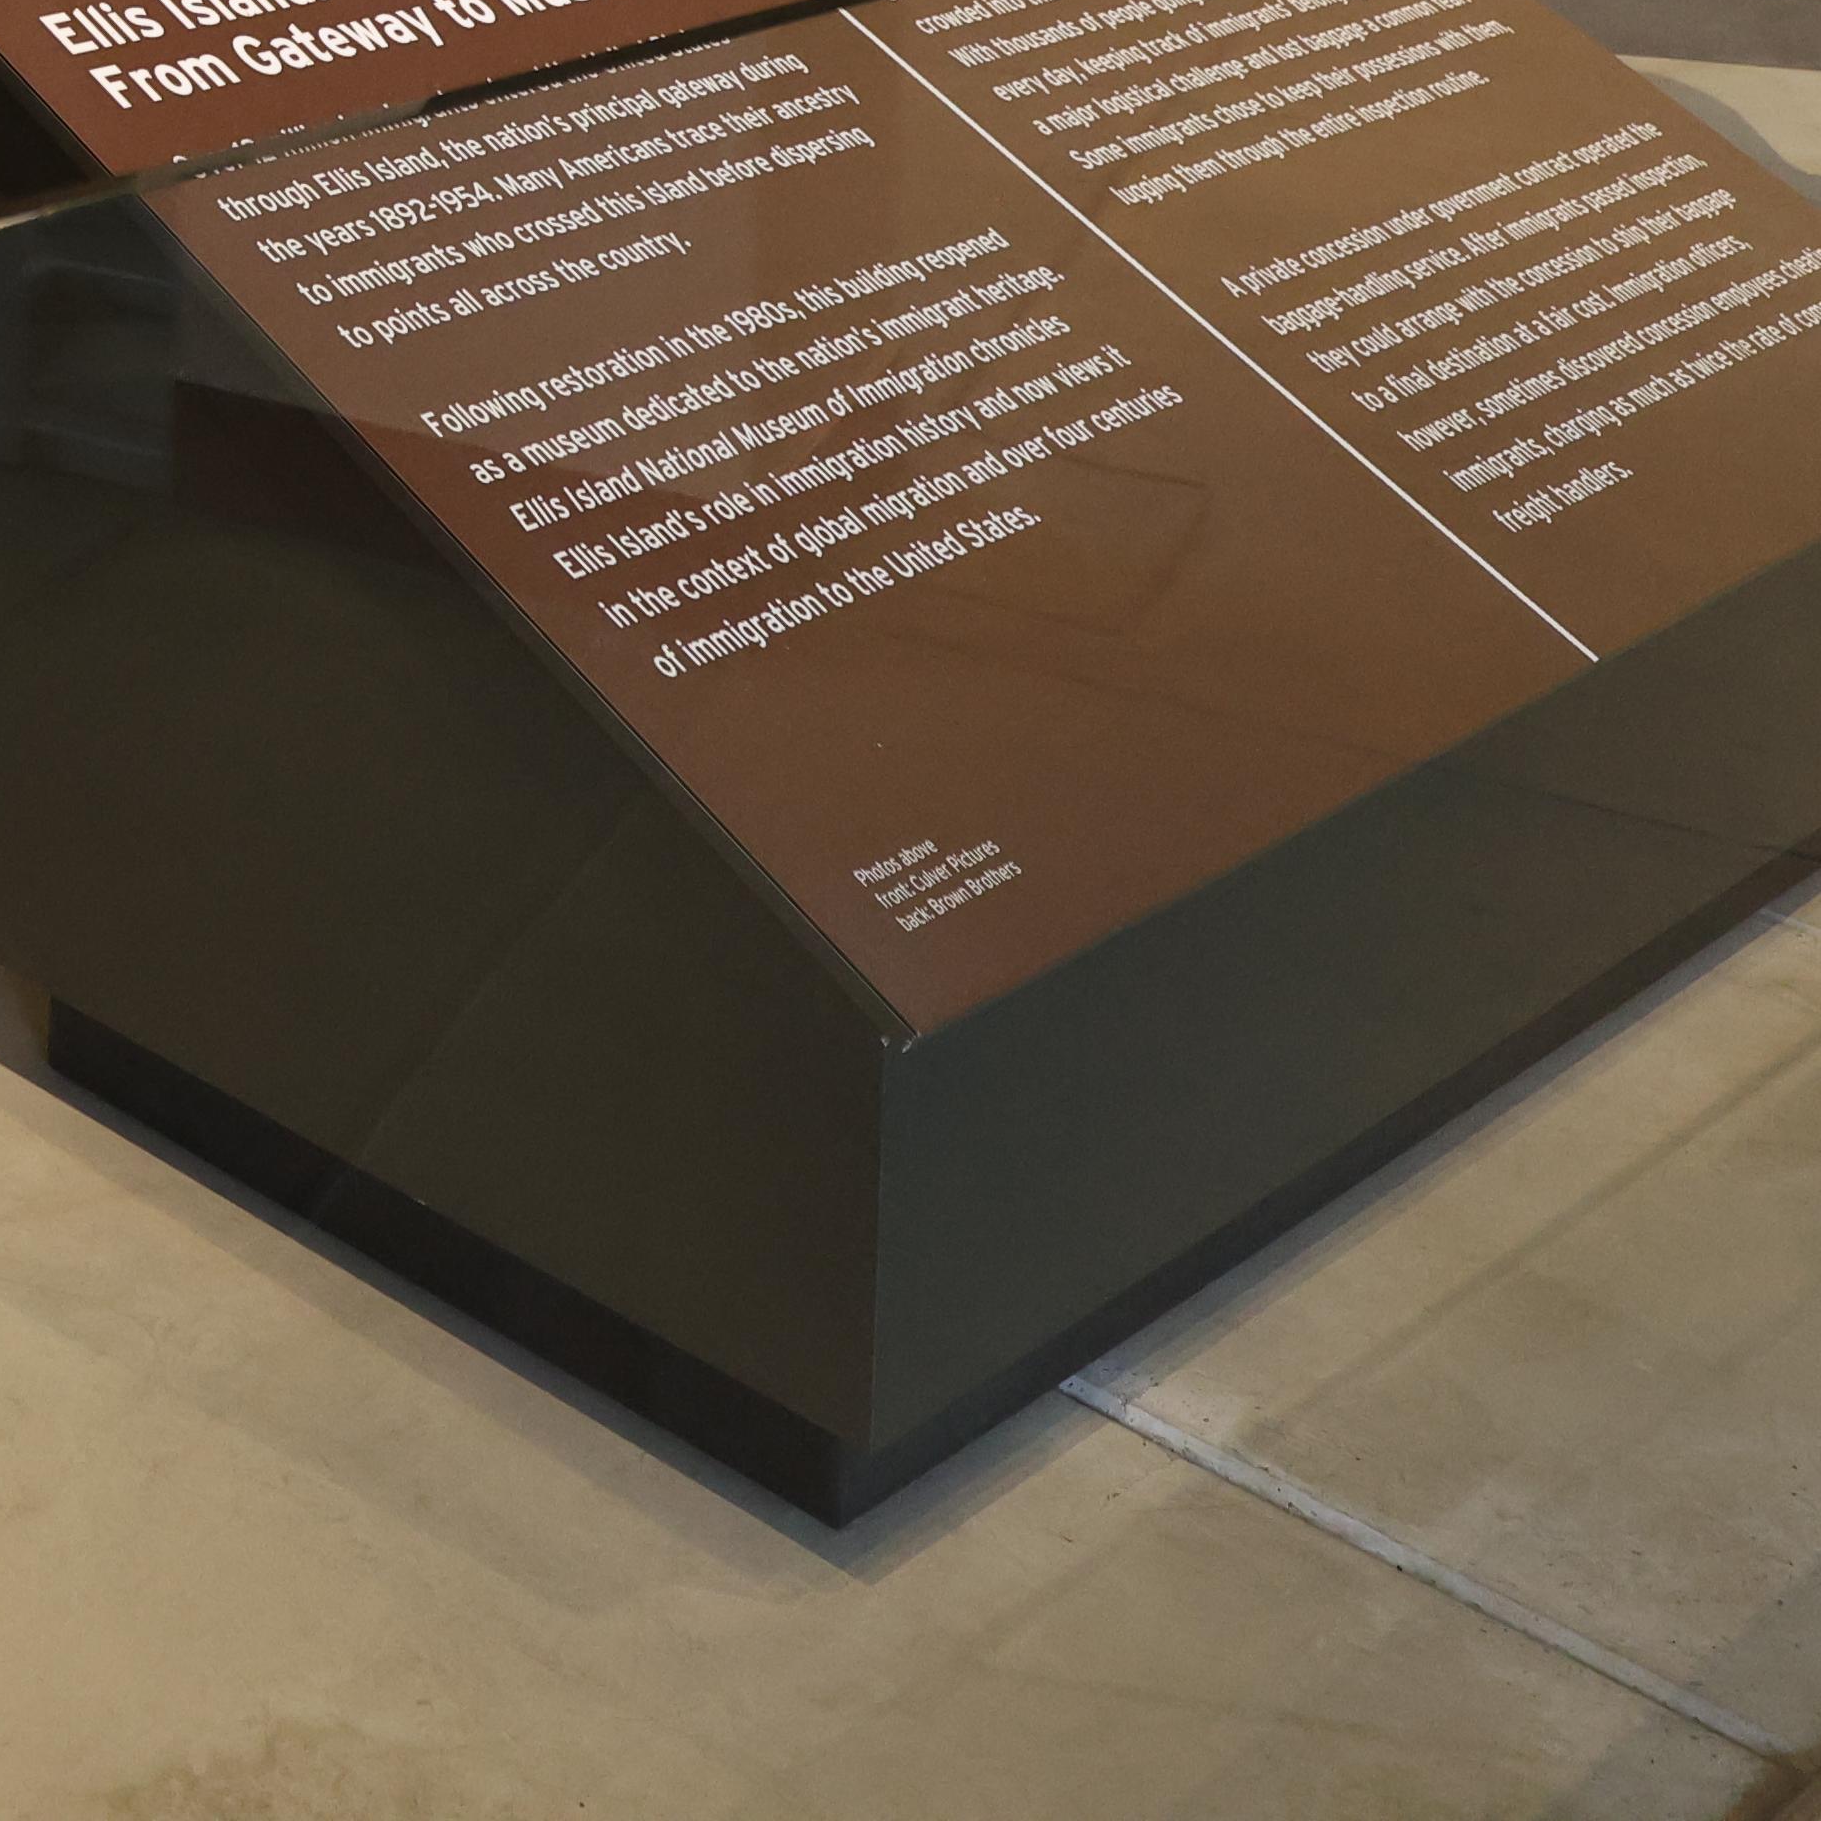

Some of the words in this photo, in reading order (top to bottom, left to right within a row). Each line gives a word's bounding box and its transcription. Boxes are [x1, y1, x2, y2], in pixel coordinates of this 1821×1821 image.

[38, 1, 165, 56] Ellis
[87, 52, 242, 110] From
[231, 5, 445, 76] Gateway
[914, 0, 994, 35] crowded
[946, 41, 1002, 69] With
[988, 18, 1085, 57] thousands
[1078, 10, 1104, 33] of
[216, 179, 322, 222] through
[311, 166, 372, 197] Ellis
[362, 145, 451, 183] Island,
[438, 138, 487, 163] the
[481, 113, 573, 152] nation's
[566, 87, 663, 134] principal
[656, 69, 746, 109] gateway
[738, 53, 810, 83] during
[255, 237, 308, 264] the
[302, 218, 377, 257] years
[368, 180, 504, 233] 1892-1954.
[492, 166, 565, 198] Many
[557, 136, 674, 181] Americans
[663, 121, 729, 150] trace
[717, 105, 775, 134] their
[770, 84, 861, 121] ancestry
[295, 281, 334, 306] to
[324, 243, 467, 298] immigrants
[460, 230, 516, 259] who
[512, 199, 604, 244] crossed
[593, 190, 647, 219] this
[634, 169, 710, 207] island
[697, 155, 775, 188] before
[769, 126, 876, 169] dispersing
[1220, 276, 1249, 299] A
[1238, 256, 1306, 297] private
[1298, 224, 1393, 270] concession
[1381, 206, 1435, 236] under
[1427, 171, 1523, 223] government
[1513, 150, 1582, 187] contract
[1571, 127, 1641, 166] operated
[1625, 121, 1663, 142] the
[336, 324, 375, 349] to
[370, 301, 452, 346] points
[447, 287, 485, 317] all
[479, 269, 561, 307] across
[550, 257, 601, 284] the
[596, 231, 693, 271] country.
[419, 385, 548, 439] Following
[536, 344, 672, 401] restoration
[657, 334, 696, 359] in
[683, 323, 734, 350] the
[722, 300, 808, 337] 1980s,
[792, 283, 845, 313] this
[832, 259, 927, 300] building
[914, 226, 1011, 274] reopened
[468, 458, 506, 485] as
[501, 451, 528, 474] a
[519, 417, 628, 467] museum
[621, 373, 737, 432] dedicated
[724, 368, 762, 393] to
[750, 356, 801, 384] the
[793, 325, 884, 370] nation's
[869, 288, 983, 341] immigrant
[968, 265, 1066, 307] heritage.
[508, 494, 571, 533] Ellis
[562, 464, 645, 513] Island
[634, 429, 740, 487] National
[729, 402, 831, 452] Museum
[825, 386, 854, 418] of
[844, 349, 976, 409] Immigration
[968, 315, 1072, 363] chronicles
[551, 541, 618, 580] Ellis
[605, 508, 709, 560] Island's
[700, 490, 756, 526] role
[742, 480, 782, 507] in
[767, 433, 909, 498] immigration
[894, 405, 983, 448] history
[972, 385, 1020, 420] and
[1009, 374, 1060, 405] now
[1050, 354, 1115, 389] views
[1099, 343, 1133, 369] it
[597, 600, 639, 630] in
[626, 585, 682, 618] the
[676, 544, 774, 601] context
[766, 531, 800, 564] of
[793, 505, 869, 559] global
[859, 471, 970, 527] migration
[960, 448, 1010, 485] and
[1000, 435, 1053, 469] over
[1041, 418, 1096, 450] four
[1089, 384, 1184, 433] centuries
[1491, 488, 1564, 534] freight
[1545, 460, 1635, 507] handlers.
[652, 643, 688, 679] of
[674, 593, 829, 667] immigration
[814, 581, 855, 608] to
[842, 565, 895, 597] the
[881, 528, 969, 579] United
[955, 505, 1043, 549] States.
[852, 857, 903, 888] Photos
[897, 839, 939, 868] above
[908, 862, 953, 892] Culver
[945, 839, 1001, 873] Pictures
[926, 886, 974, 916] Brown
[963, 860, 1022, 897] Brothers
